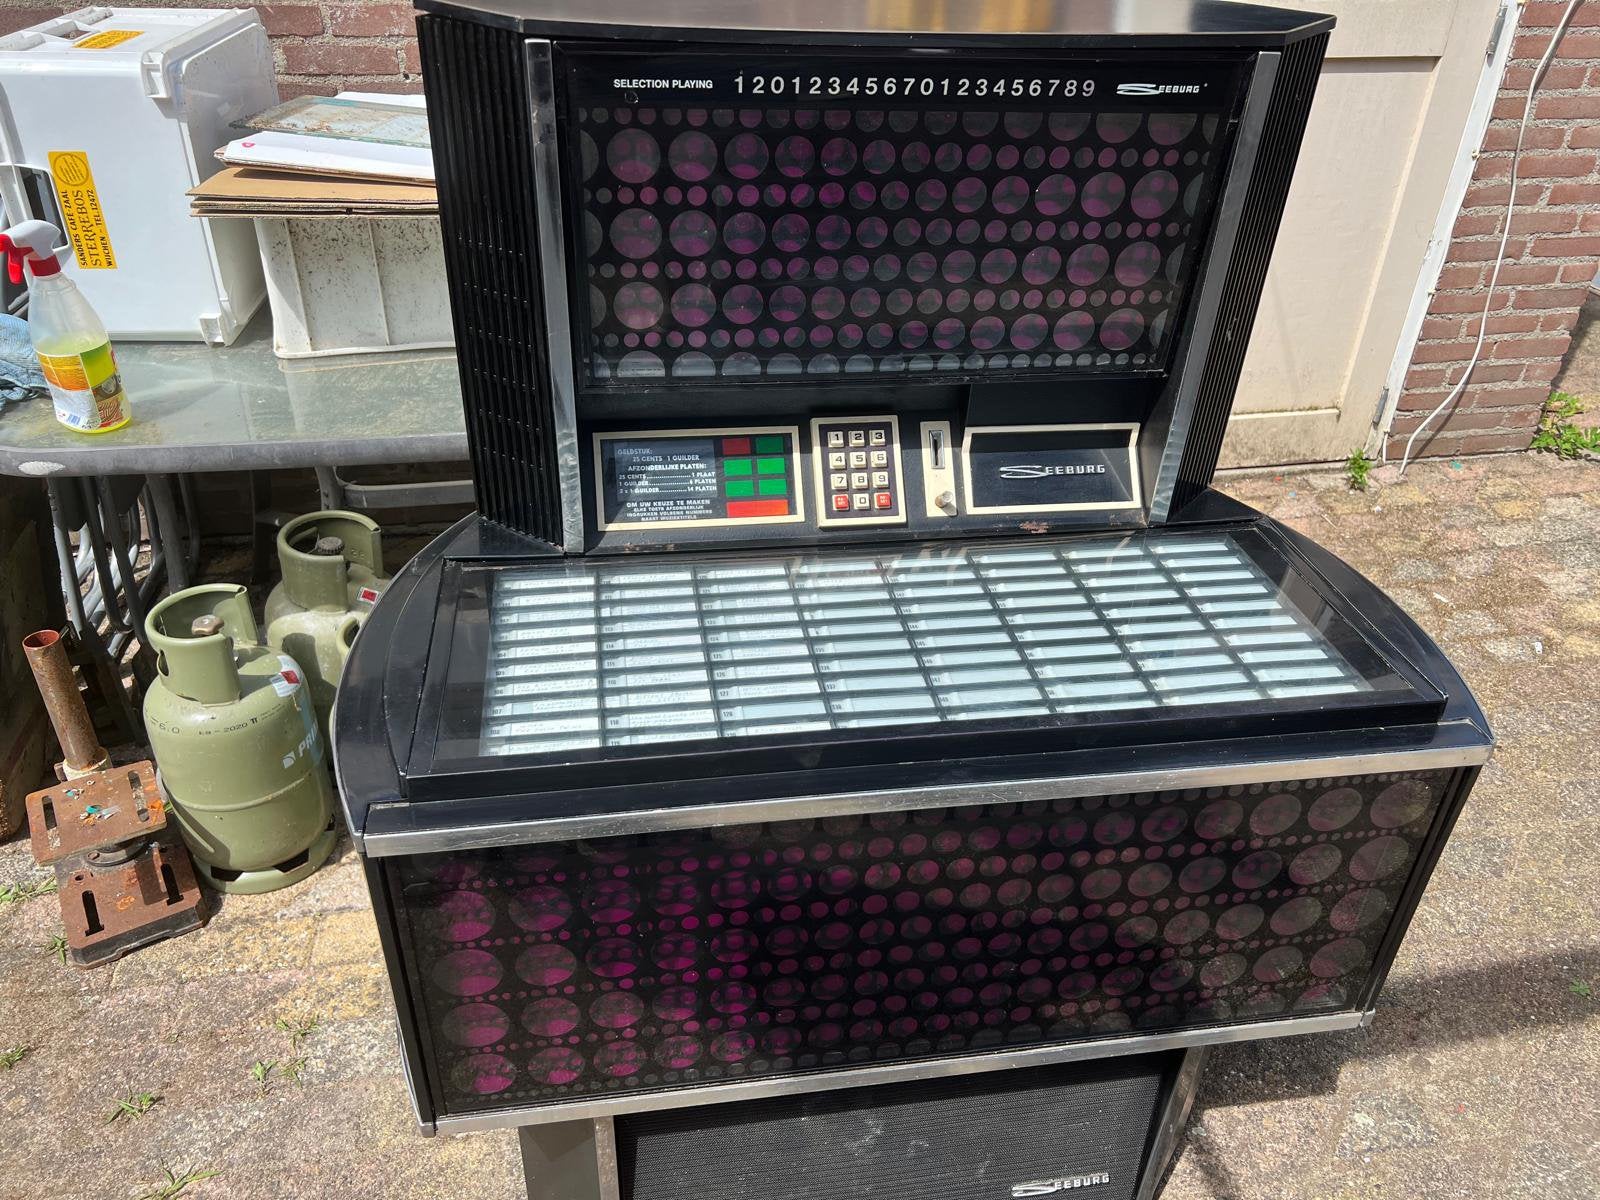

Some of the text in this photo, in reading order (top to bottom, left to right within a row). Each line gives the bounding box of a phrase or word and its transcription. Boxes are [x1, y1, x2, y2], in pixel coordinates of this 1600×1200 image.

[613, 79, 713, 89] SELECTION PLAYING
[1116, 83, 1200, 96] SEEBURG
[72, 189, 102, 267] STERREBOS
[73, 233, 87, 266] SANDERS
[100, 236, 113, 267] WIJCHEN
[875, 432, 883, 440] 3
[628, 463, 679, 472] AFZONDERLIJKE
[1000, 464, 1106, 479] SEEBURG
[223, 722, 248, 733] 2020
[1011, 1174, 1110, 1197] SEEBURG
